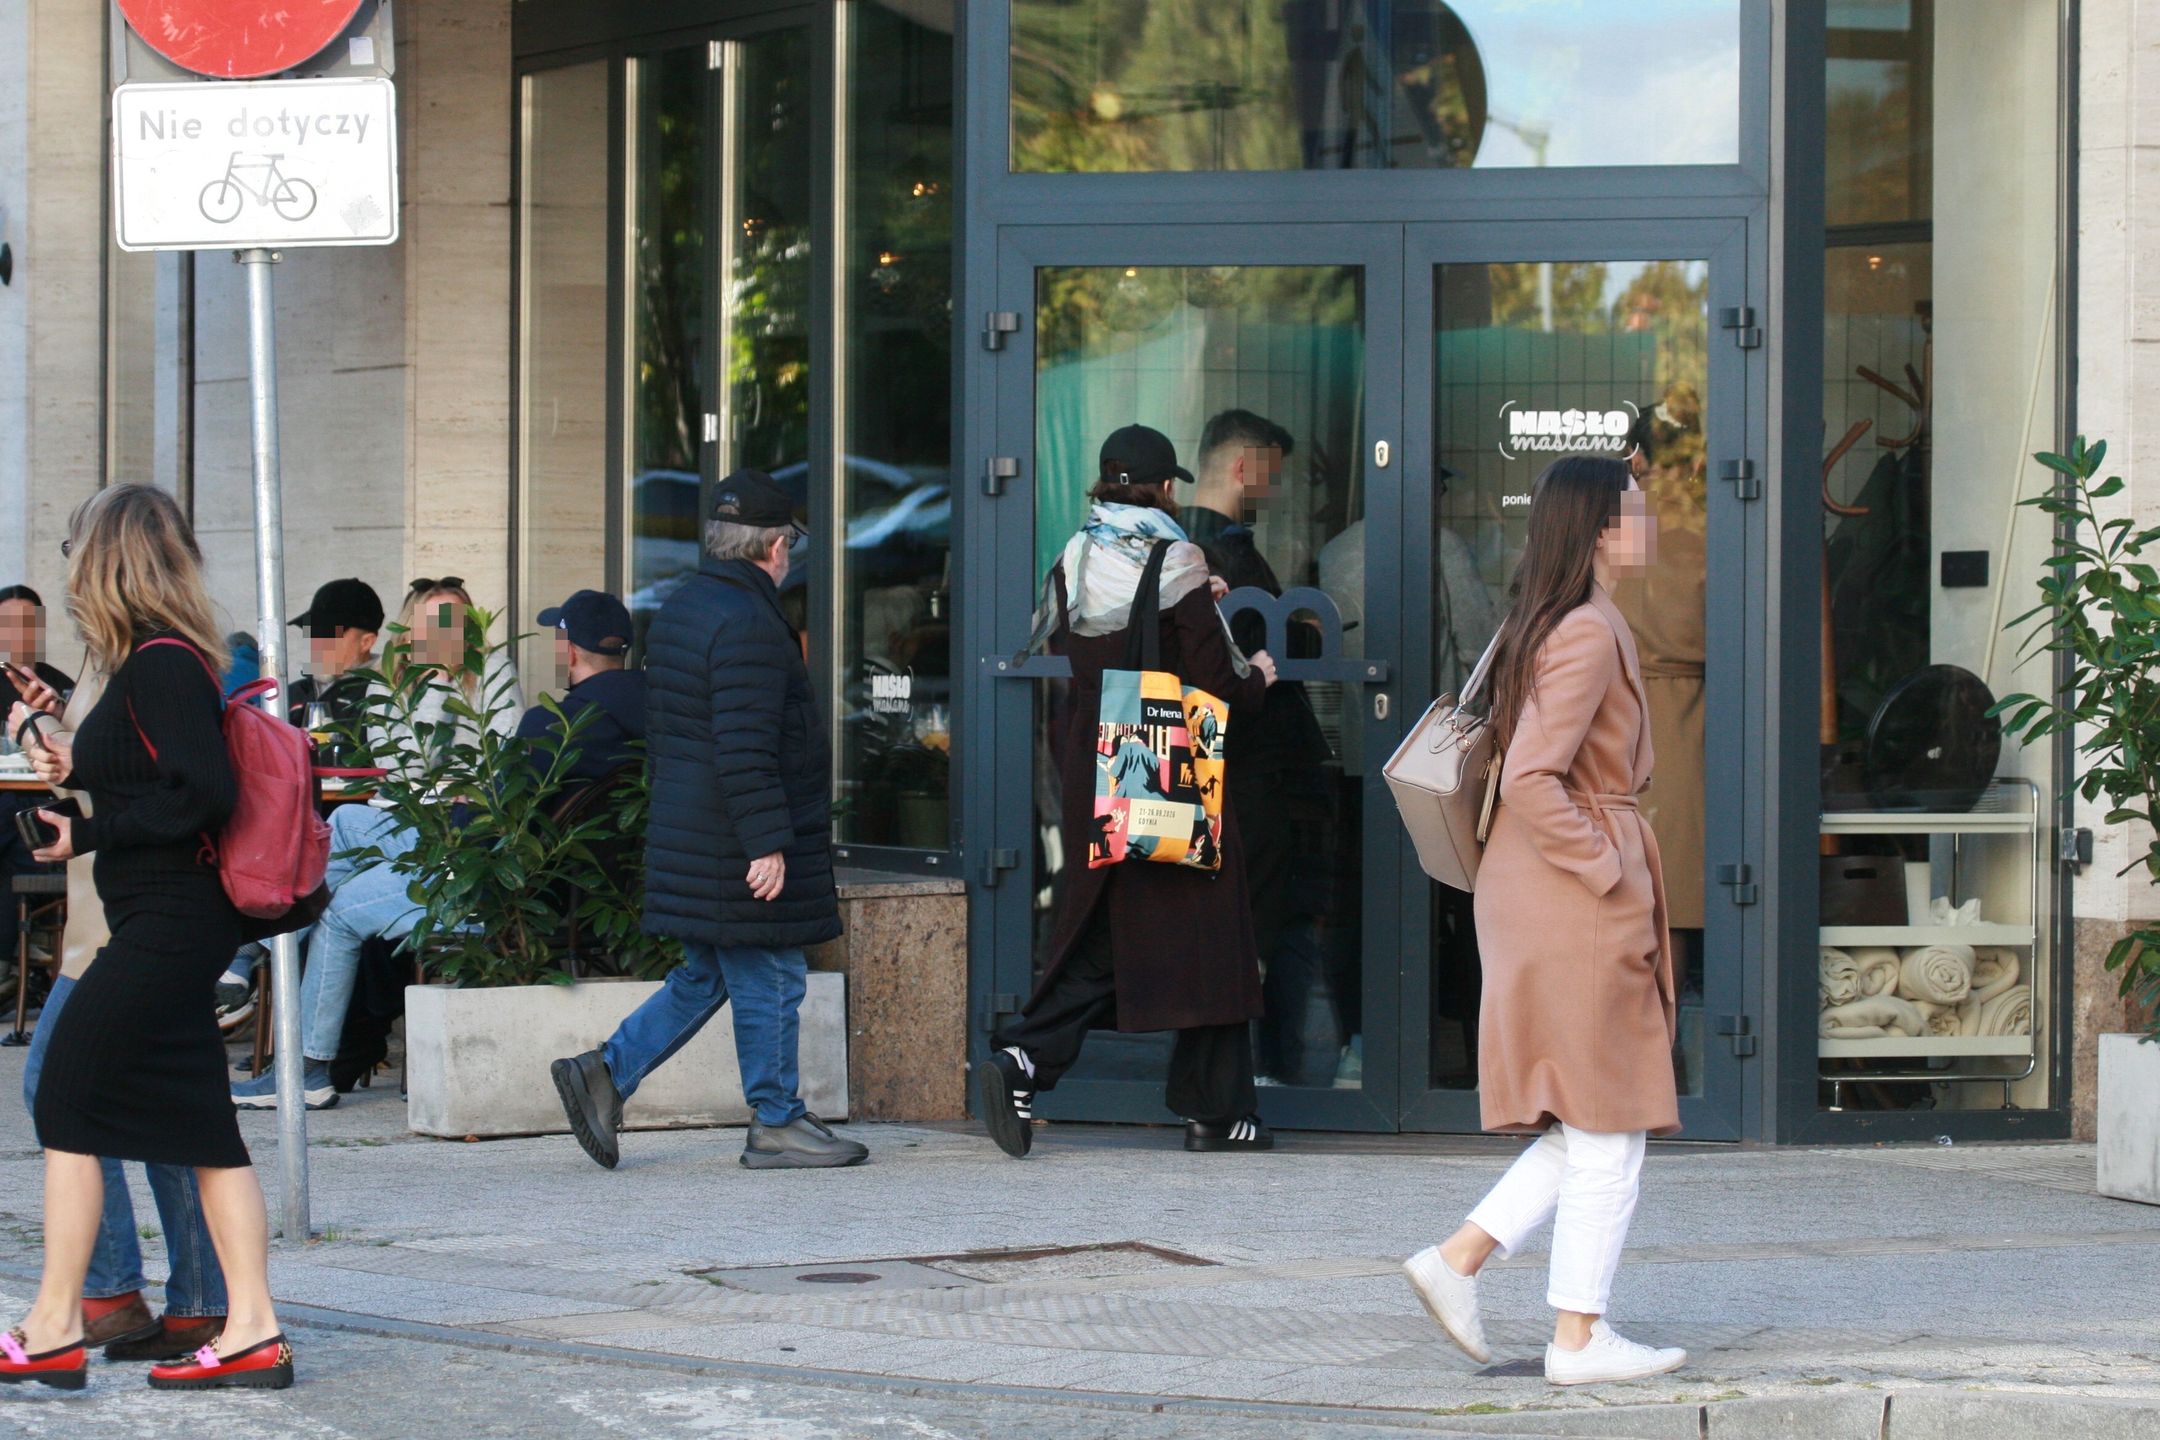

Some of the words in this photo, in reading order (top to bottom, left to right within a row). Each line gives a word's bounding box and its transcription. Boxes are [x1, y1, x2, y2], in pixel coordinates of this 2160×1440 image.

[139, 109, 202, 140] Nie
[227, 107, 370, 146] dotyczy
[1509, 409, 1629, 436] MASŁO
[1147, 706, 1159, 717] Dr
[1160, 708, 1182, 719] Irena
